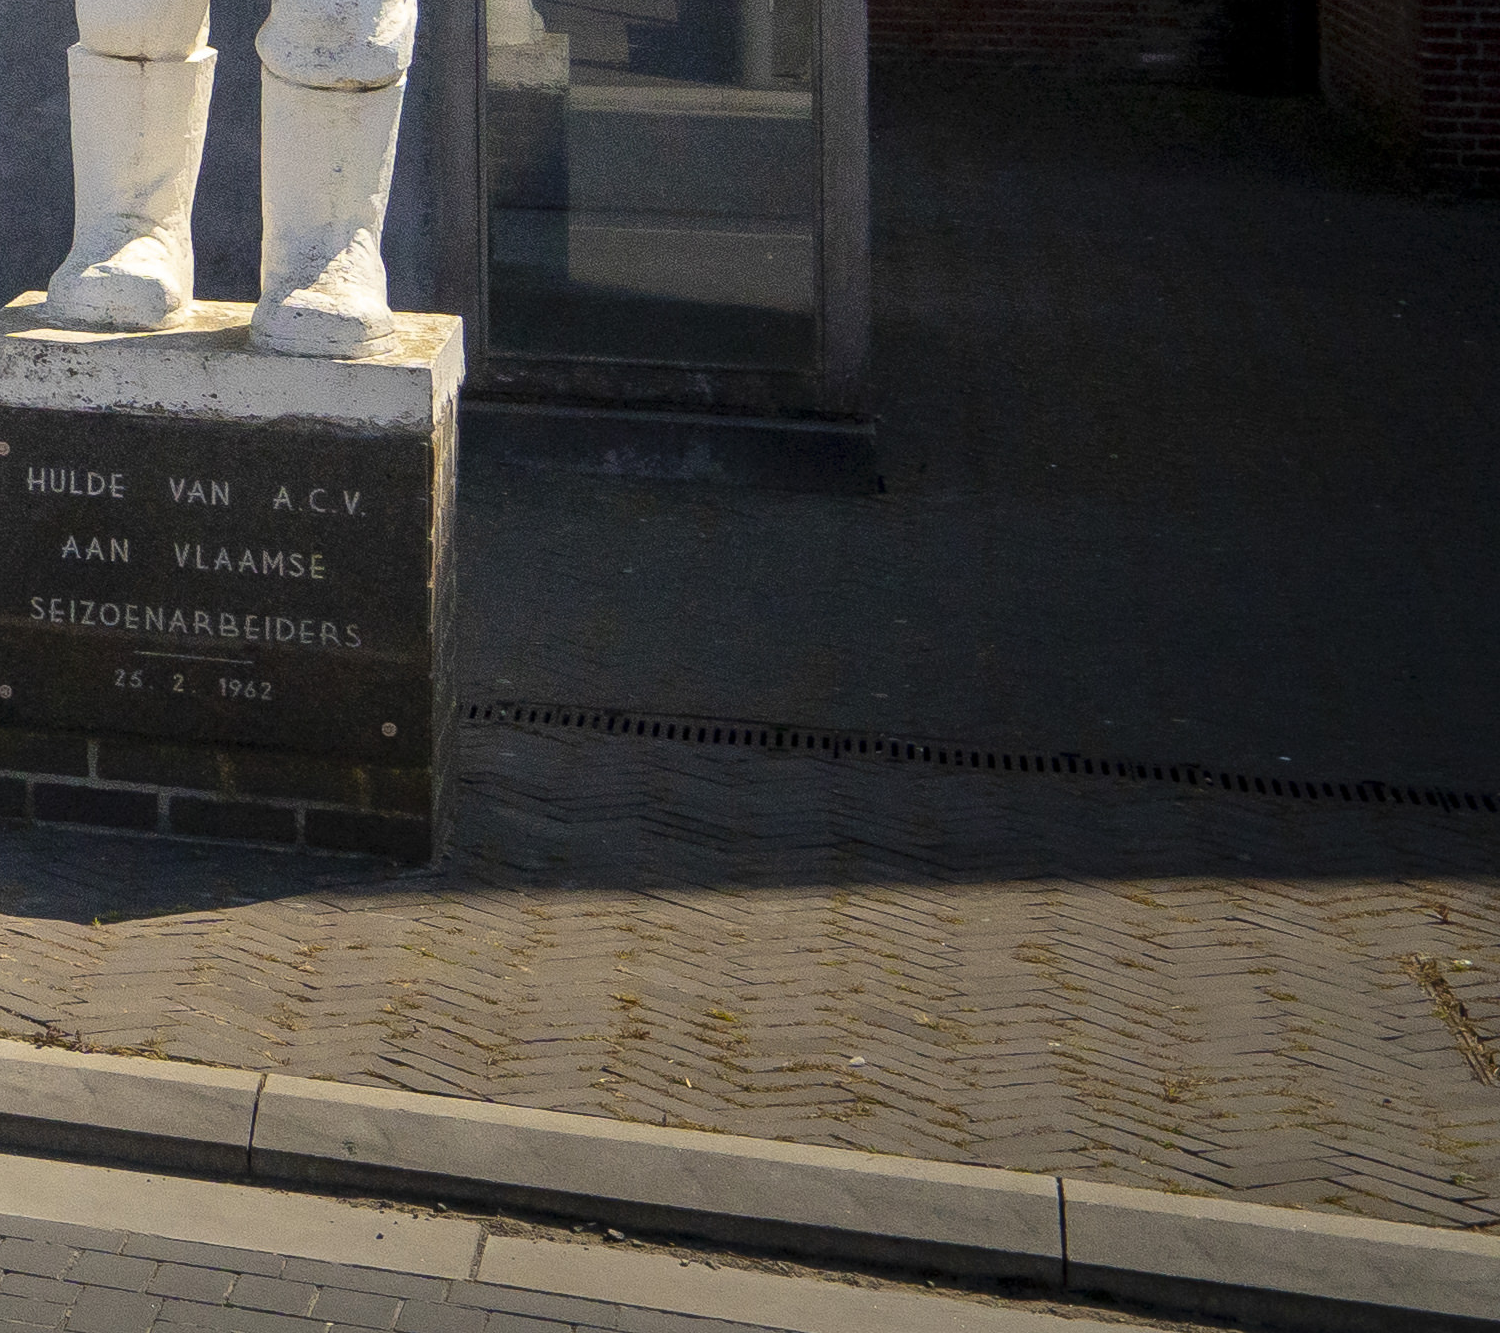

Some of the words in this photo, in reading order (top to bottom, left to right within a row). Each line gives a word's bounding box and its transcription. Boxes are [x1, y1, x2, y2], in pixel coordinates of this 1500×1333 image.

[27, 467, 124, 498] HULDE
[169, 477, 229, 506] VAN
[62, 535, 129, 562] AAN
[174, 542, 325, 579] VLAAMSE
[31, 596, 362, 648] SEIZOENARBEIDERS
